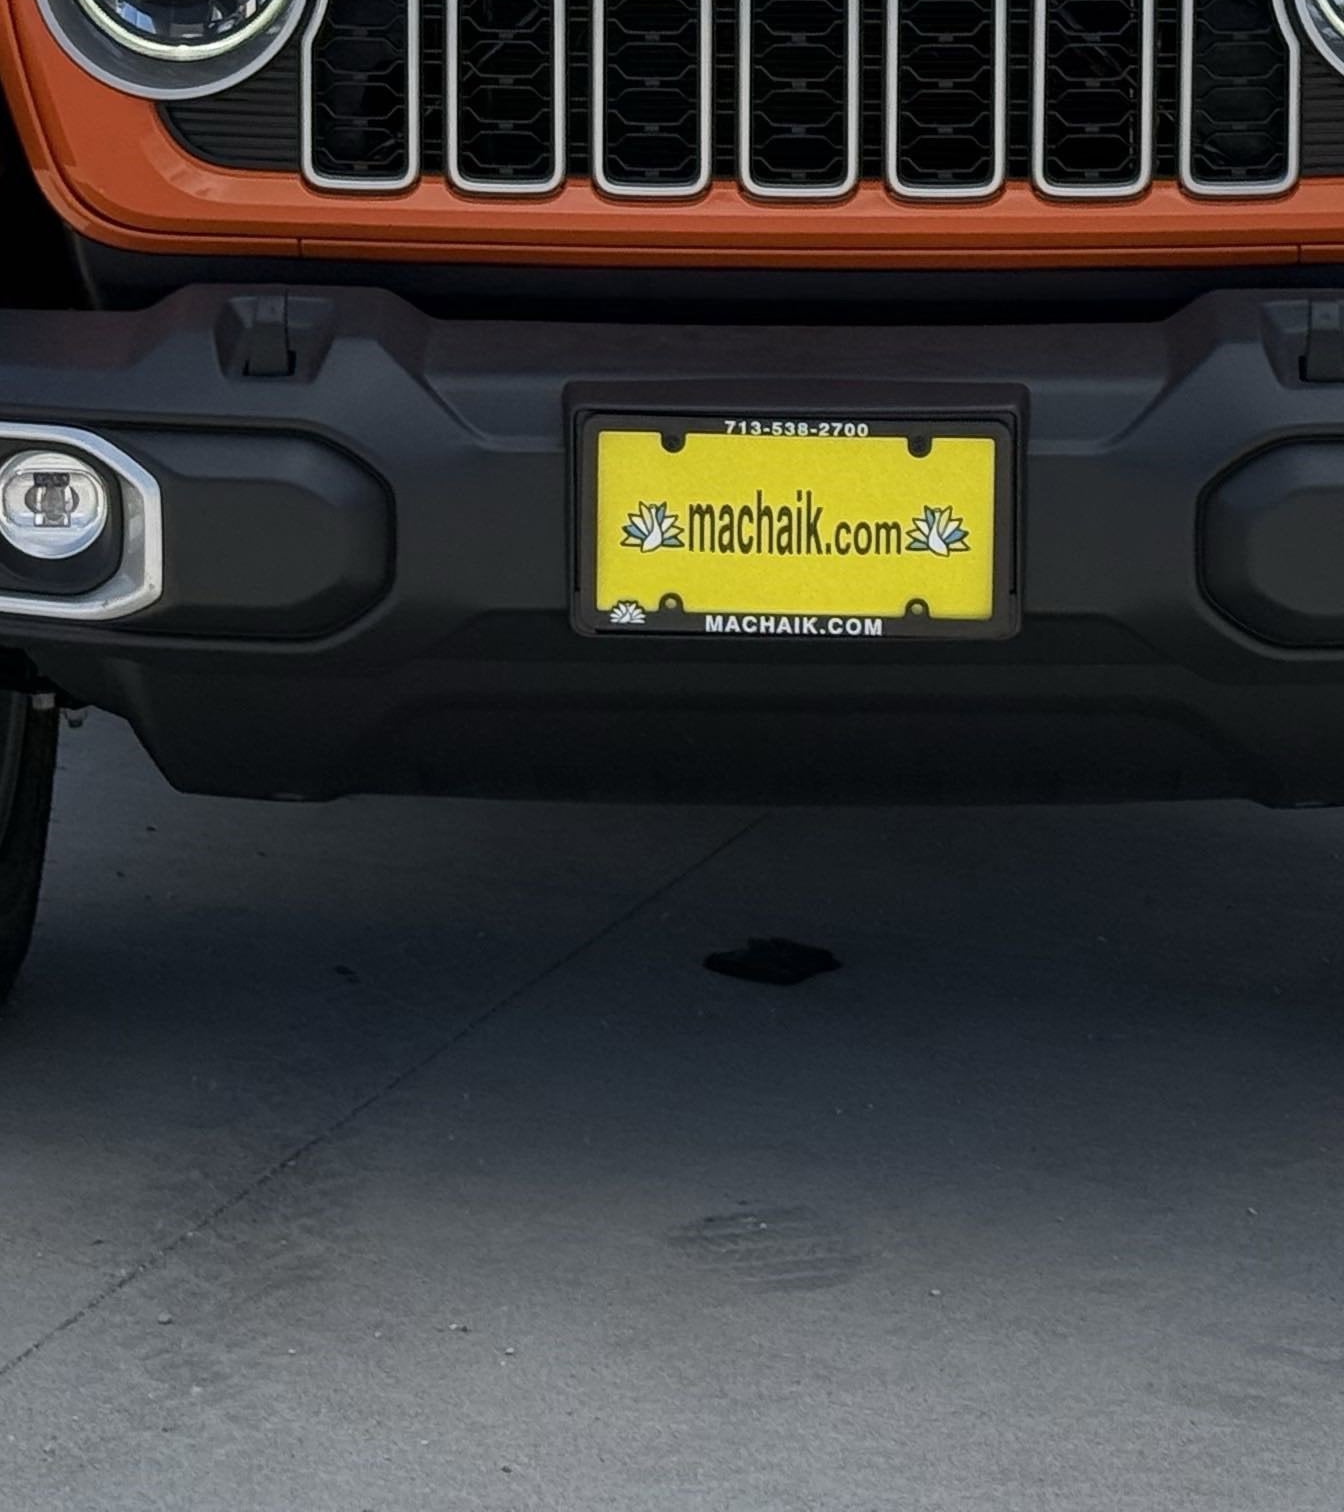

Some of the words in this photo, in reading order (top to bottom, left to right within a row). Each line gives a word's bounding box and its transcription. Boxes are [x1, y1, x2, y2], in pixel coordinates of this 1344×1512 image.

[724, 419, 869, 438] 713-538-2700
[687, 489, 902, 556] machaik.com
[704, 613, 884, 637] MACHAIK.COM
